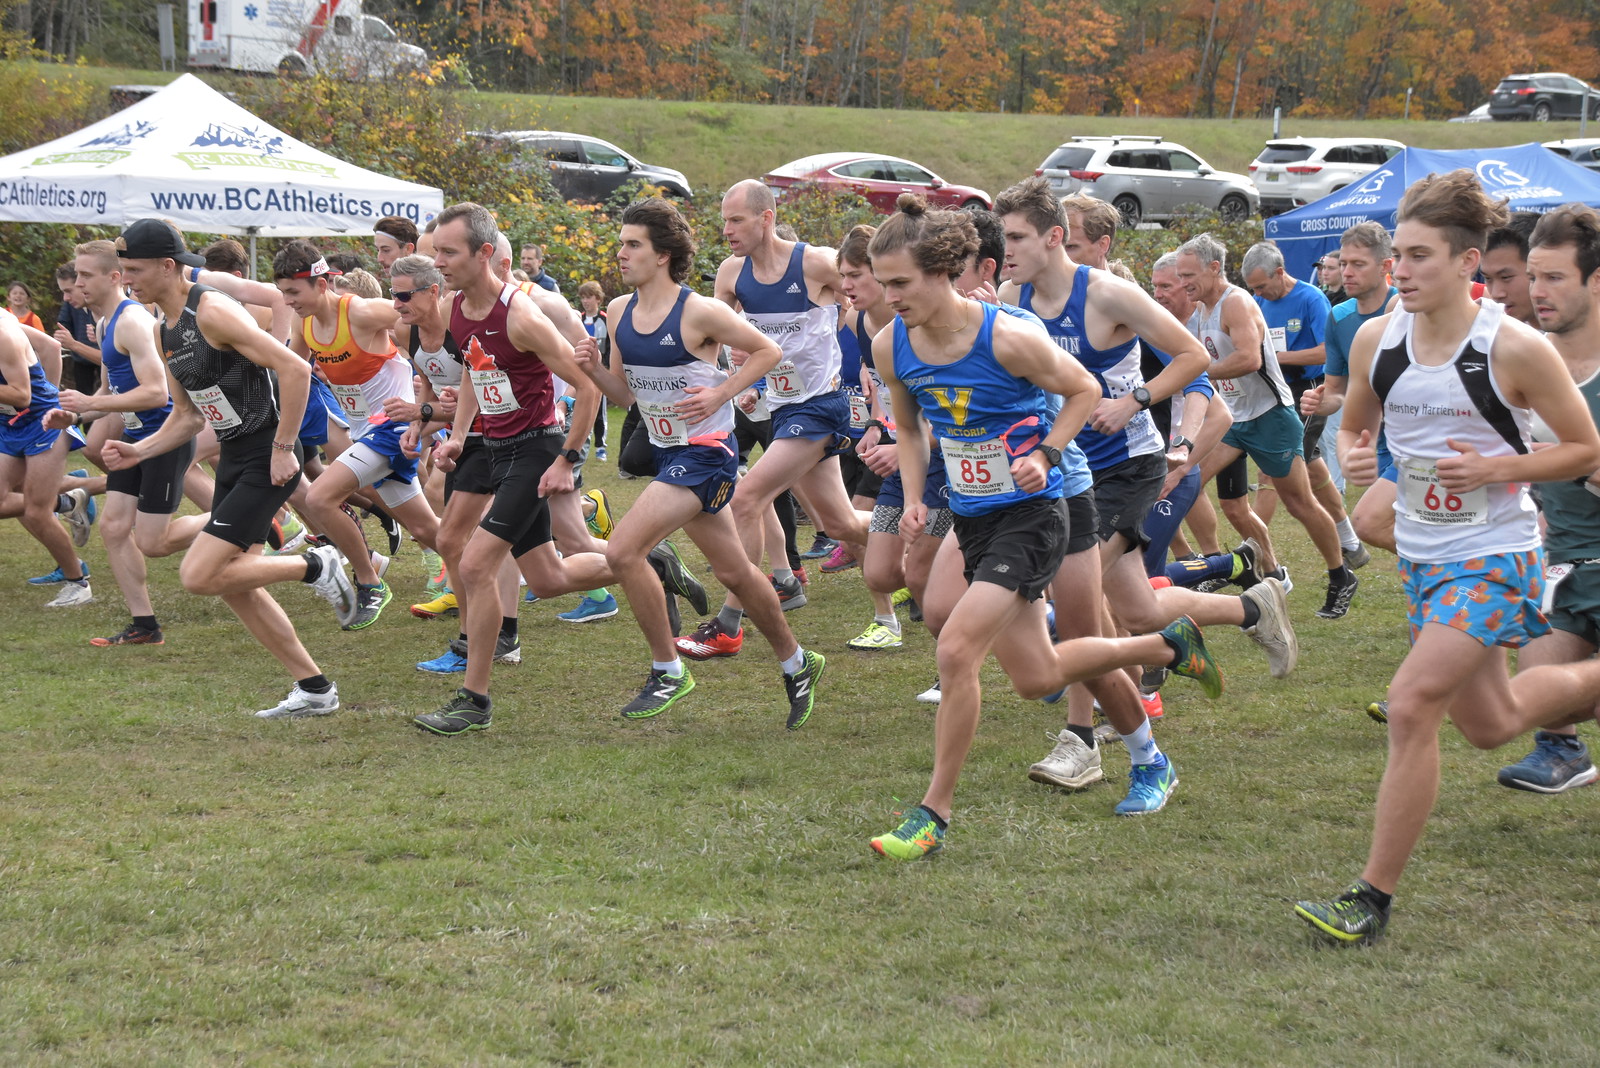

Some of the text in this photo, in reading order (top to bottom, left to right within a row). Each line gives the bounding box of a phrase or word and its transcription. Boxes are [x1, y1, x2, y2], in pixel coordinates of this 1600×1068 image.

[183, 153, 328, 175] BC ATHLETICS
[151, 187, 420, 225] www.BCAthletics.org
[1301, 217, 1328, 232] CROSS
[760, 322, 801, 335] SPARTANS
[635, 376, 688, 393] SPARTANS
[770, 375, 793, 391] 72
[483, 385, 503, 405] 43
[201, 404, 224, 421] 58
[1389, 402, 1456, 416] Hershey Harriers
[649, 417, 673, 436] 10
[946, 426, 988, 437] VICTORIA
[960, 459, 992, 484] 85
[979, 481, 1005, 490] COUNTRY
[1424, 483, 1463, 512] 66
[1419, 515, 1473, 523] CHAMPIONSHIPS
[1424, 510, 1444, 518] CROSS
